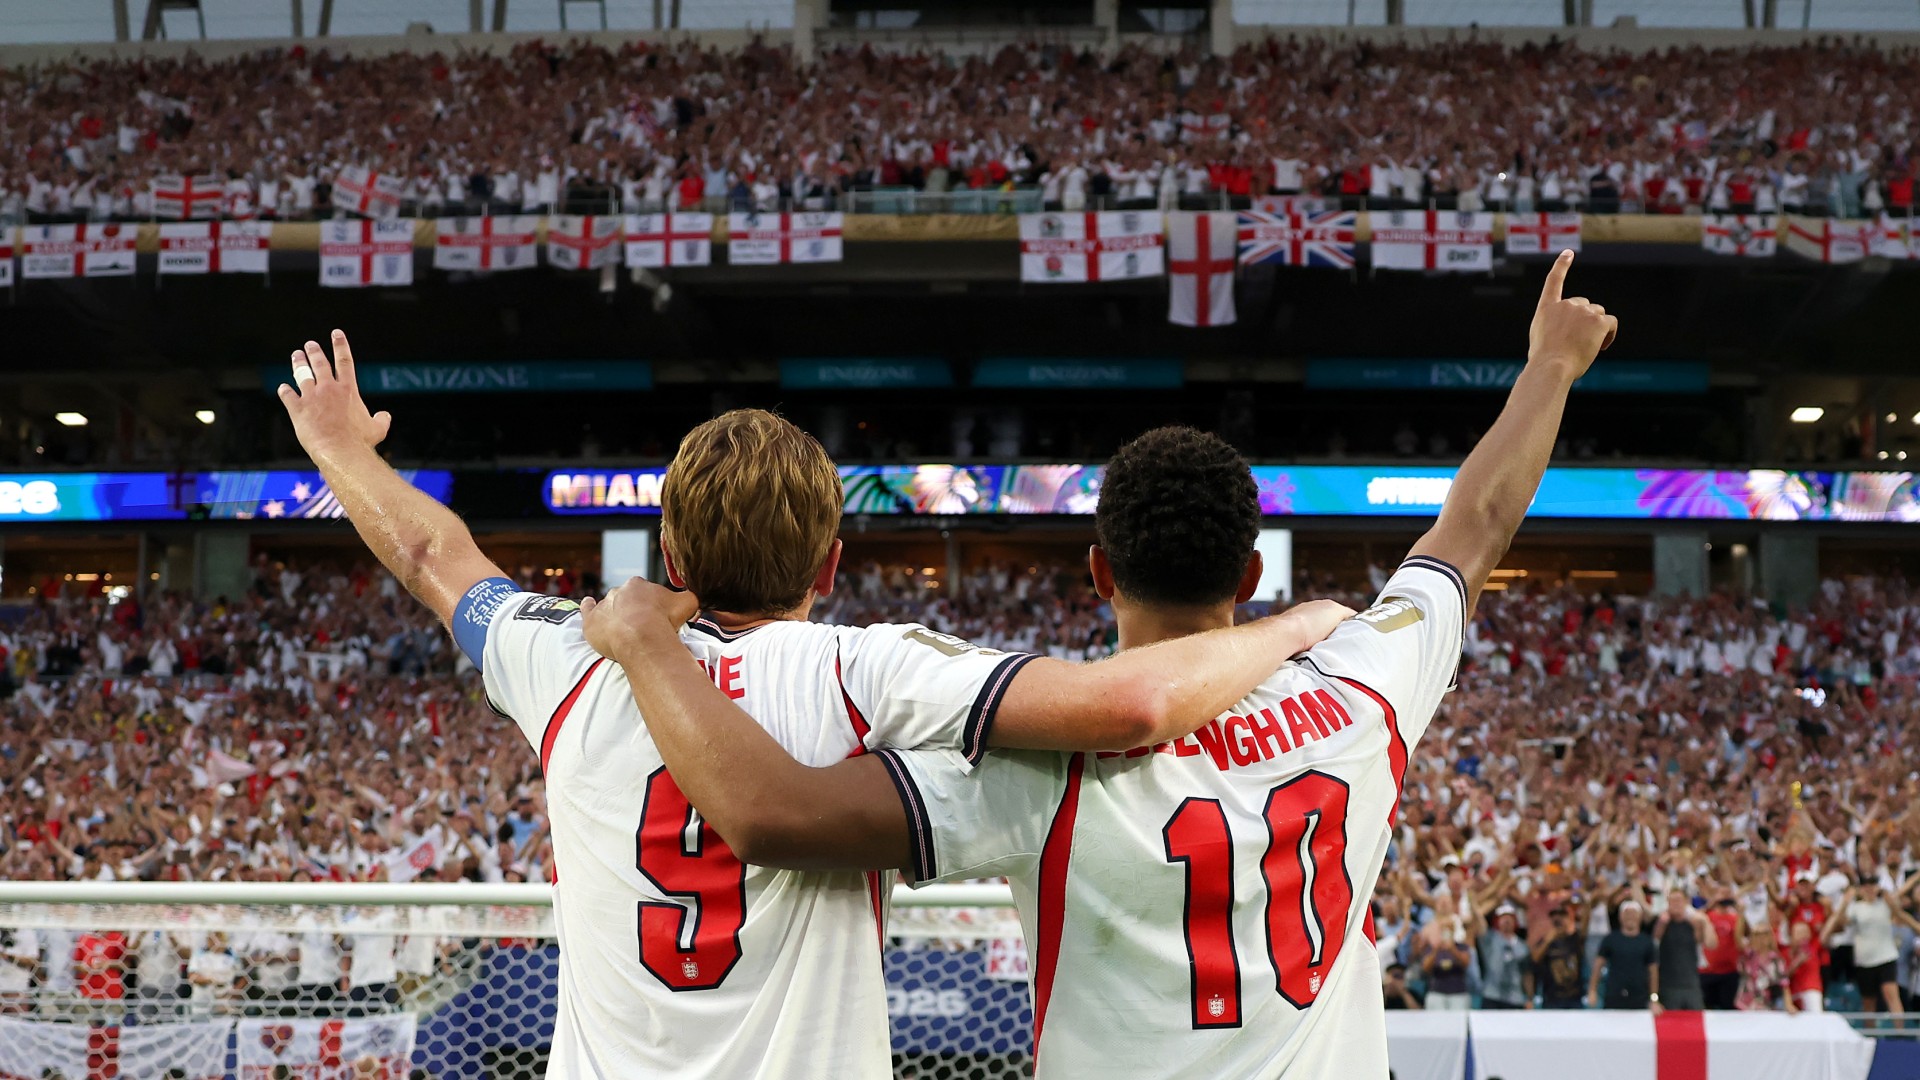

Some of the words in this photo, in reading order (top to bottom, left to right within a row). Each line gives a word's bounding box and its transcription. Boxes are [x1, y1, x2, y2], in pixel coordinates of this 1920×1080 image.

[380, 365, 529, 390] ENDZONE
[818, 366, 917, 382] ENDZONE
[1028, 366, 1126, 382] ENDZONE
[1430, 363, 1522, 387] ENDZ
[551, 474, 667, 507] MIAM
[468, 581, 491, 599] FIFA
[463, 589, 495, 624] World
[636, 763, 748, 992] 9
[1162, 769, 1353, 1030] 10
[886, 989, 969, 1016] 026
